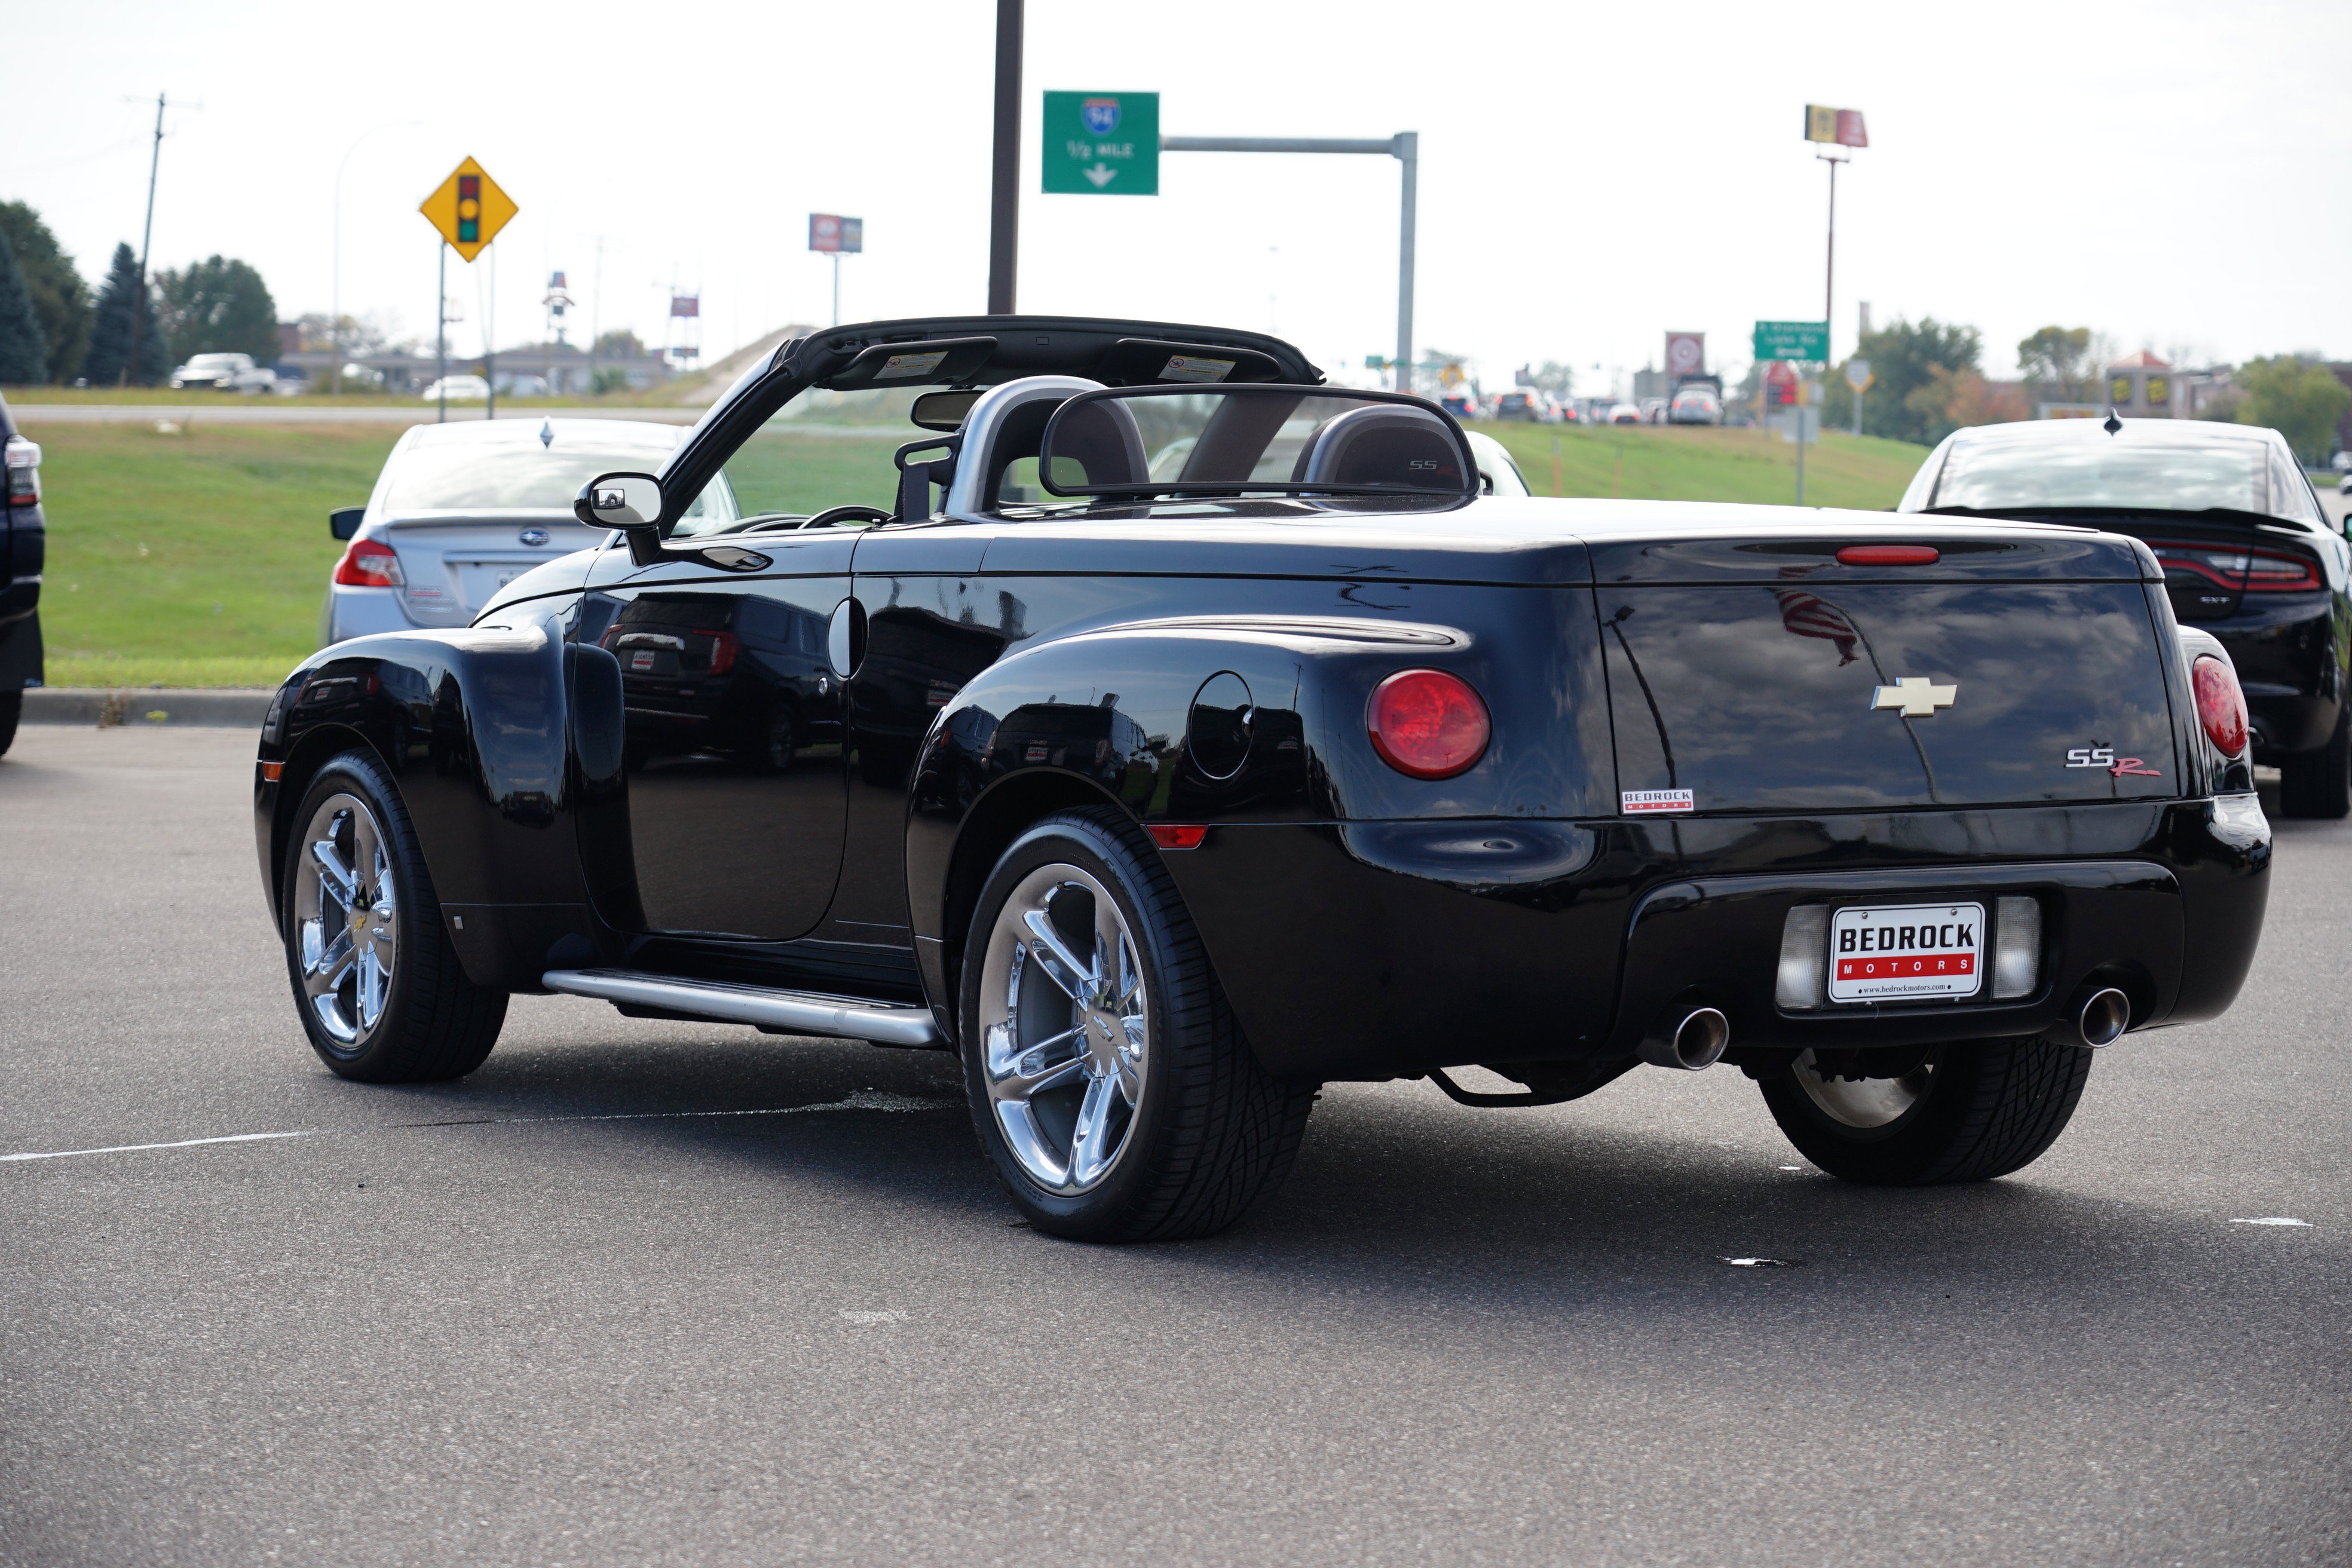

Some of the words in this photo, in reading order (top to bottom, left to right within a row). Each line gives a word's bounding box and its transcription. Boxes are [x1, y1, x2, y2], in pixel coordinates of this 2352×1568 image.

[1089, 106, 1113, 124] 94
[1067, 140, 1092, 160] 1/2
[1096, 143, 1134, 158] MILE
[1625, 791, 1690, 801] BEDROCK
[1839, 923, 1974, 953] BEDROCK
[1843, 959, 1968, 974] MOTORS
[1863, 984, 1946, 994] www.bedrockmotors.com
